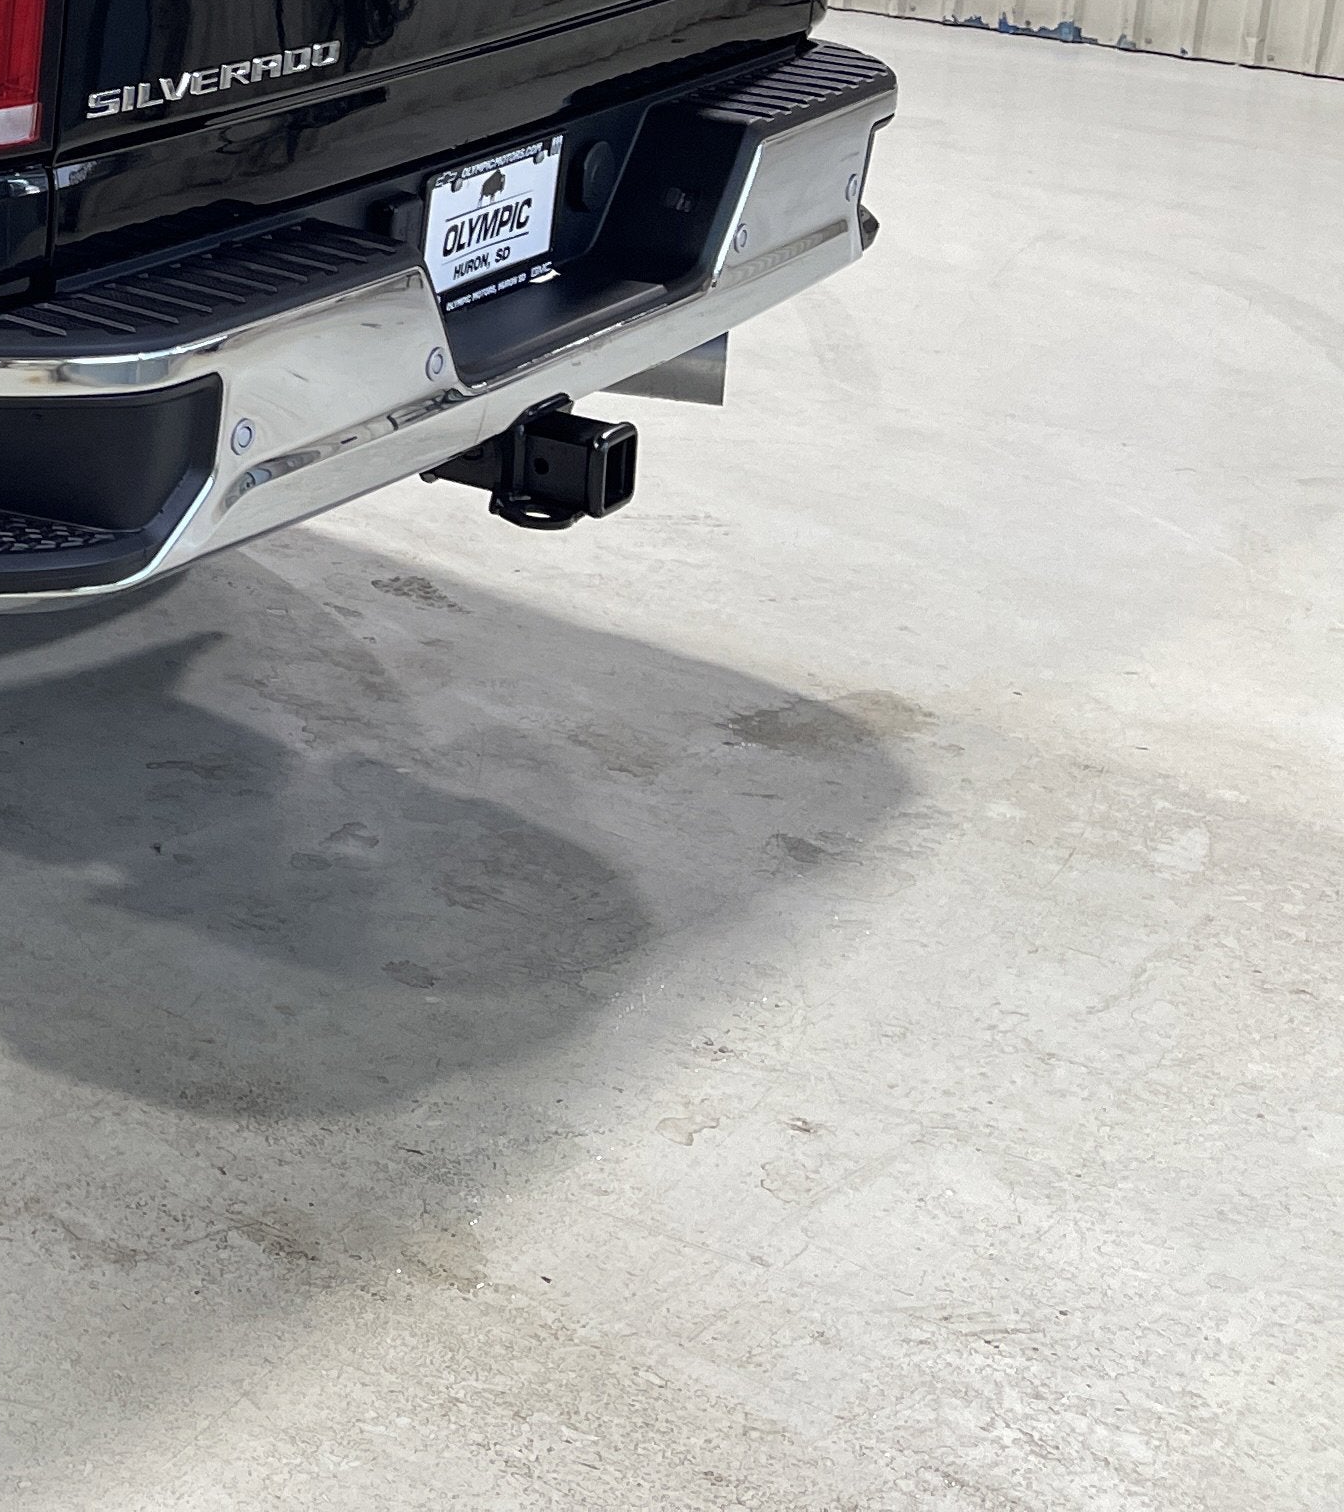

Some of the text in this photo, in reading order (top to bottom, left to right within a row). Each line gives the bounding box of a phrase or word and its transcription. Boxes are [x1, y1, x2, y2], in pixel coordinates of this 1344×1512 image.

[85, 40, 341, 120] SILVERADO
[442, 198, 532, 257] OLYMPIC
[452, 245, 511, 281] HURON, SD
